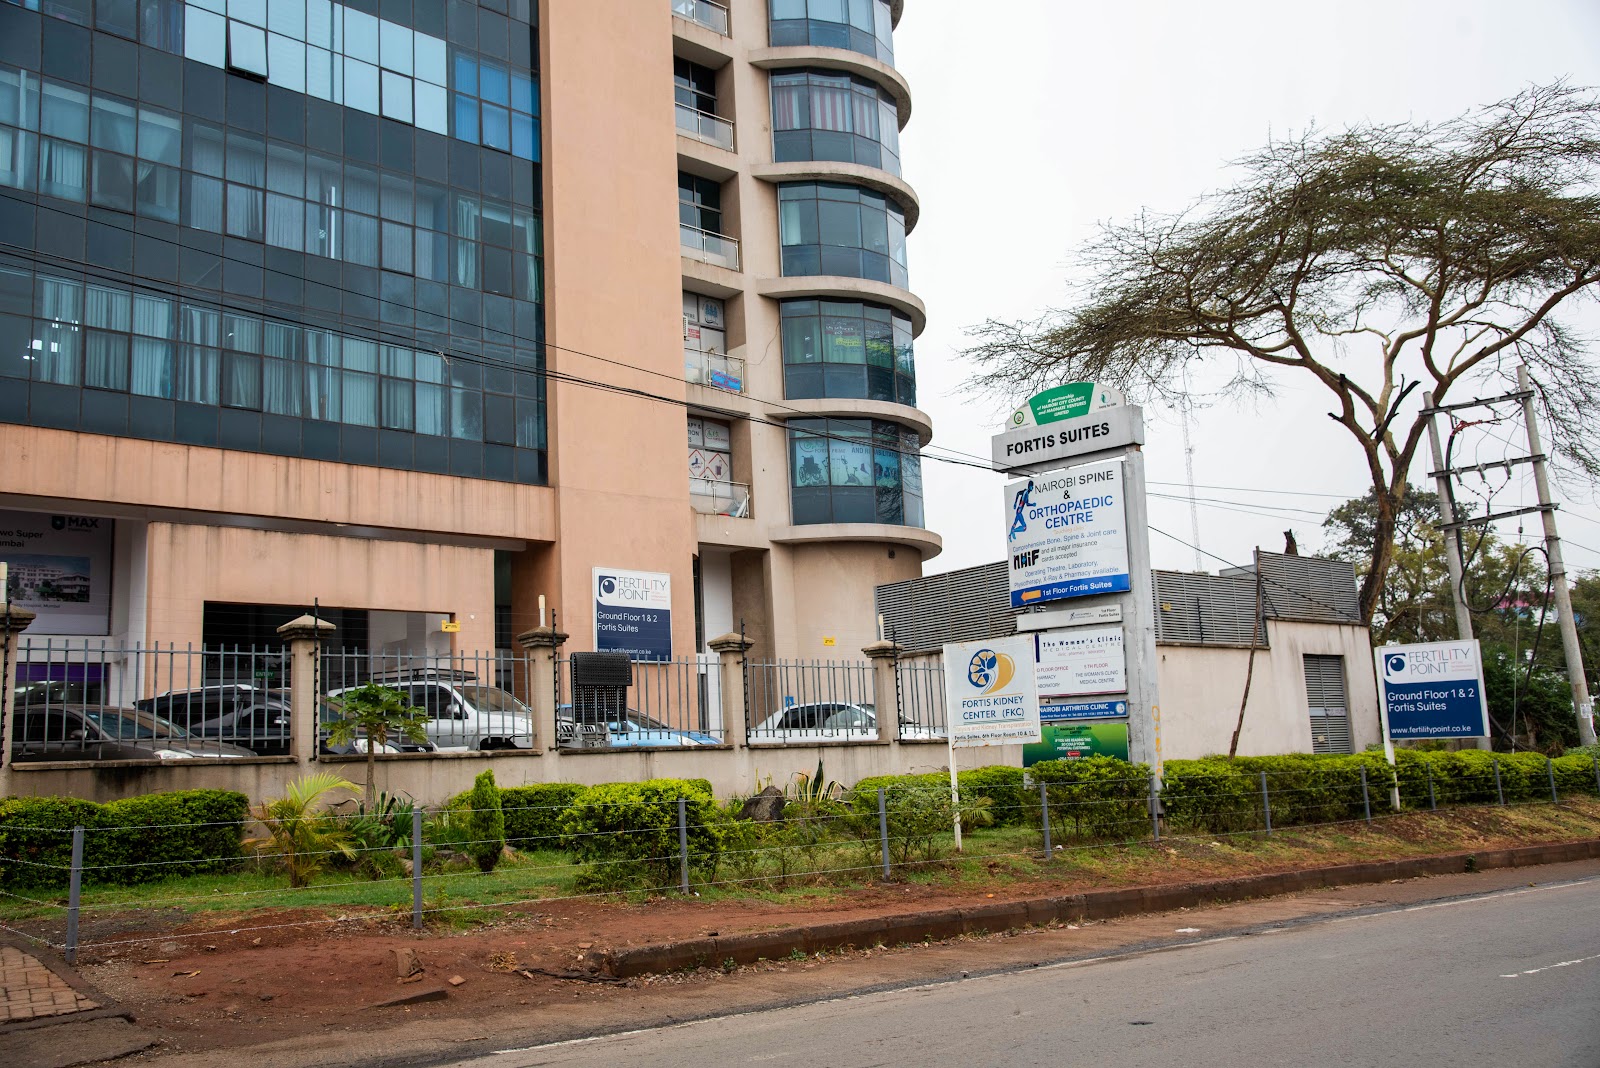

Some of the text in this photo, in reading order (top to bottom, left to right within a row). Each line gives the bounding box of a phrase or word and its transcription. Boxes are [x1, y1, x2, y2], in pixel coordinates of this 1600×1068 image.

[1068, 396, 1085, 405] COUNTY
[1007, 422, 1110, 456] FORTIS SUITES
[1035, 470, 1114, 494] NAIROBI SPINE
[1063, 490, 1070, 499] &
[1029, 496, 1113, 520] ORTHOPAEDIC
[68, 517, 98, 528] MAX
[1046, 511, 1093, 529] CENTRE
[16, 530, 43, 539] Super
[1013, 541, 1045, 553] Comprehensive
[1064, 533, 1079, 542] Spine
[1057, 544, 1070, 553] major
[1072, 540, 1097, 548] insurance
[1055, 551, 1077, 560] accepted
[1025, 568, 1045, 577] Operating
[1064, 570, 1091, 578] Pharmacy
[619, 577, 666, 591] FERTILITY
[1090, 581, 1112, 590] Suites
[619, 589, 650, 600] POINT
[597, 612, 622, 620] Ground
[624, 613, 640, 621] Floor
[598, 623, 616, 631] Fortis
[1408, 648, 1470, 662] FERTILITY
[1410, 662, 1448, 675] POINT
[1388, 688, 1474, 701] Ground Floor 1 & 2
[962, 696, 1024, 708] FORTIS KIDNEY
[1388, 702, 1446, 712] Fortis Suites
[963, 708, 1024, 720] CENTER (FKC)
[1391, 725, 1471, 734] www.fertilitypoint.co.ke
